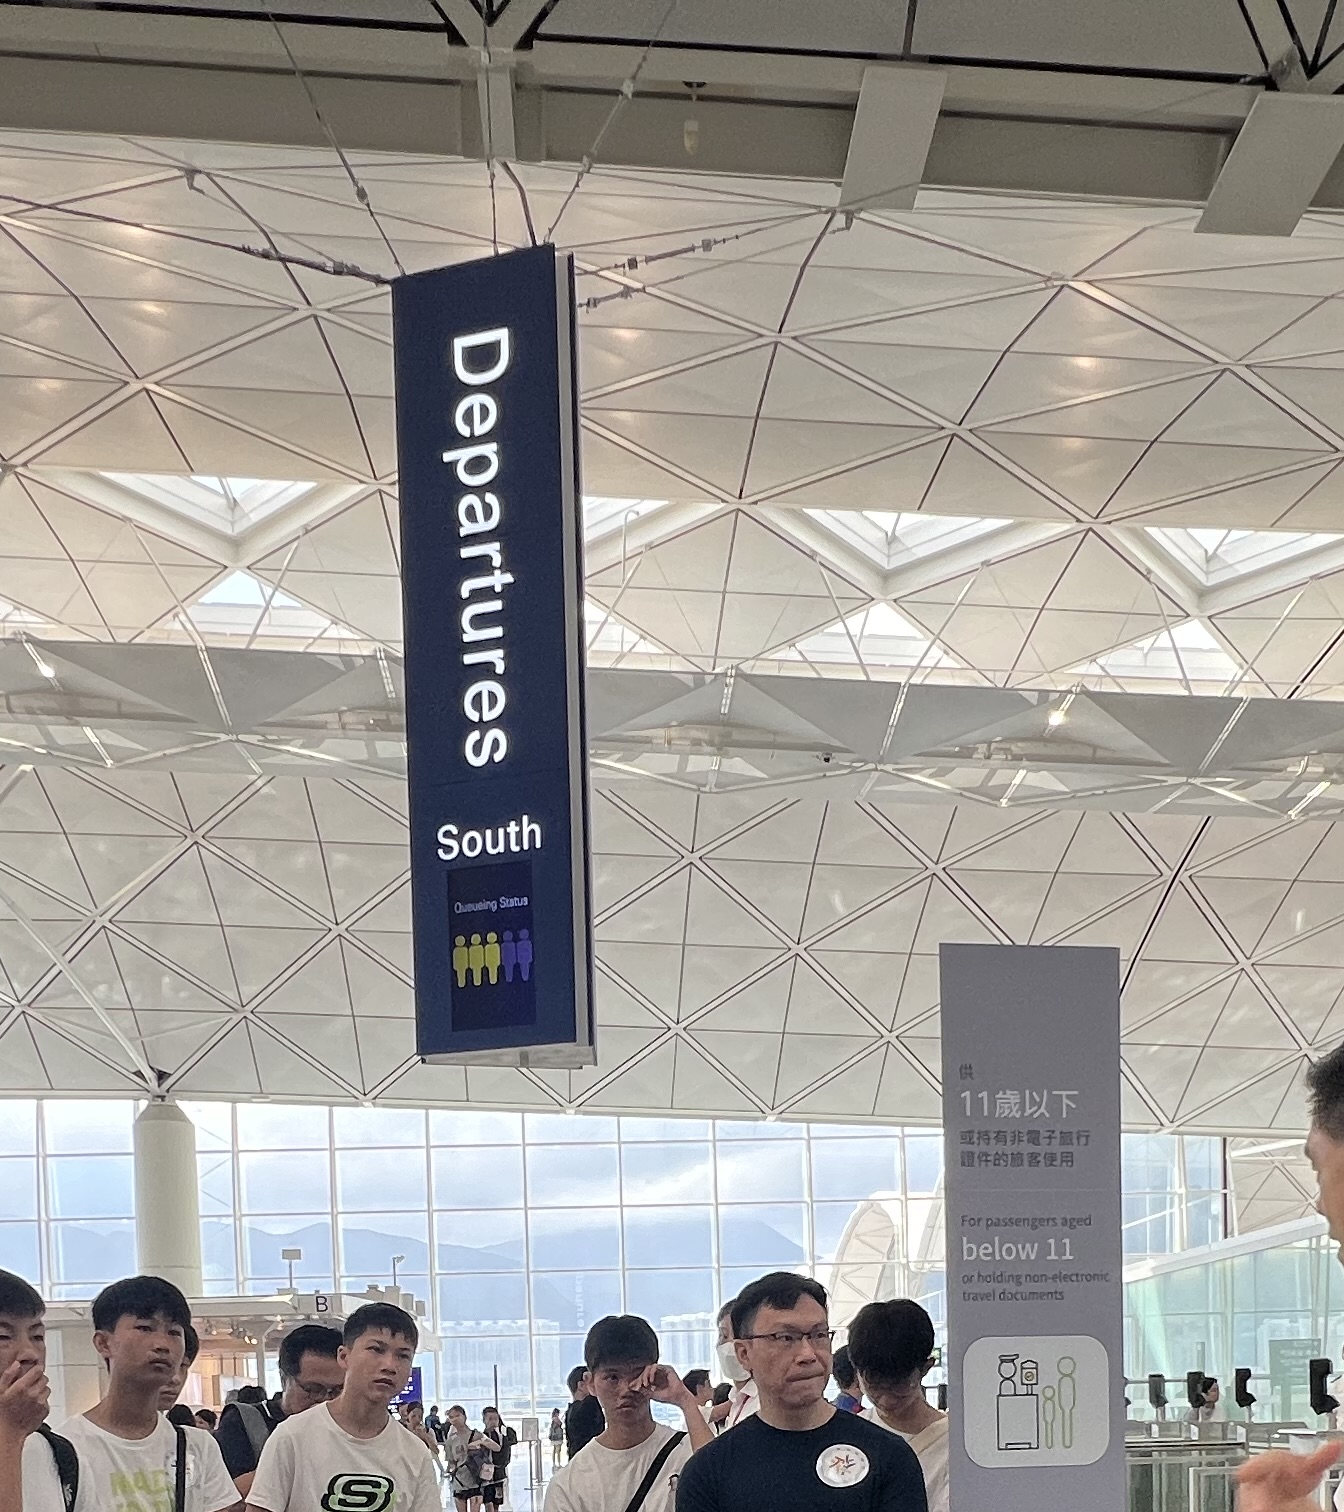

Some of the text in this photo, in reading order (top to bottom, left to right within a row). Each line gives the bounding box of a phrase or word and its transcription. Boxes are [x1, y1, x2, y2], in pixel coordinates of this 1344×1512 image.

[443, 327, 511, 769] Departures
[436, 816, 542, 860] South
[454, 896, 529, 914] Queueing Status
[959, 1063, 974, 1080] 供
[960, 1089, 1079, 1118] 11歲以下
[961, 1214, 1093, 1231] For passengers aged
[962, 1236, 1075, 1261] below 11
[961, 1270, 1110, 1287] or holding non-electronic
[962, 1289, 1065, 1302] travel documents
